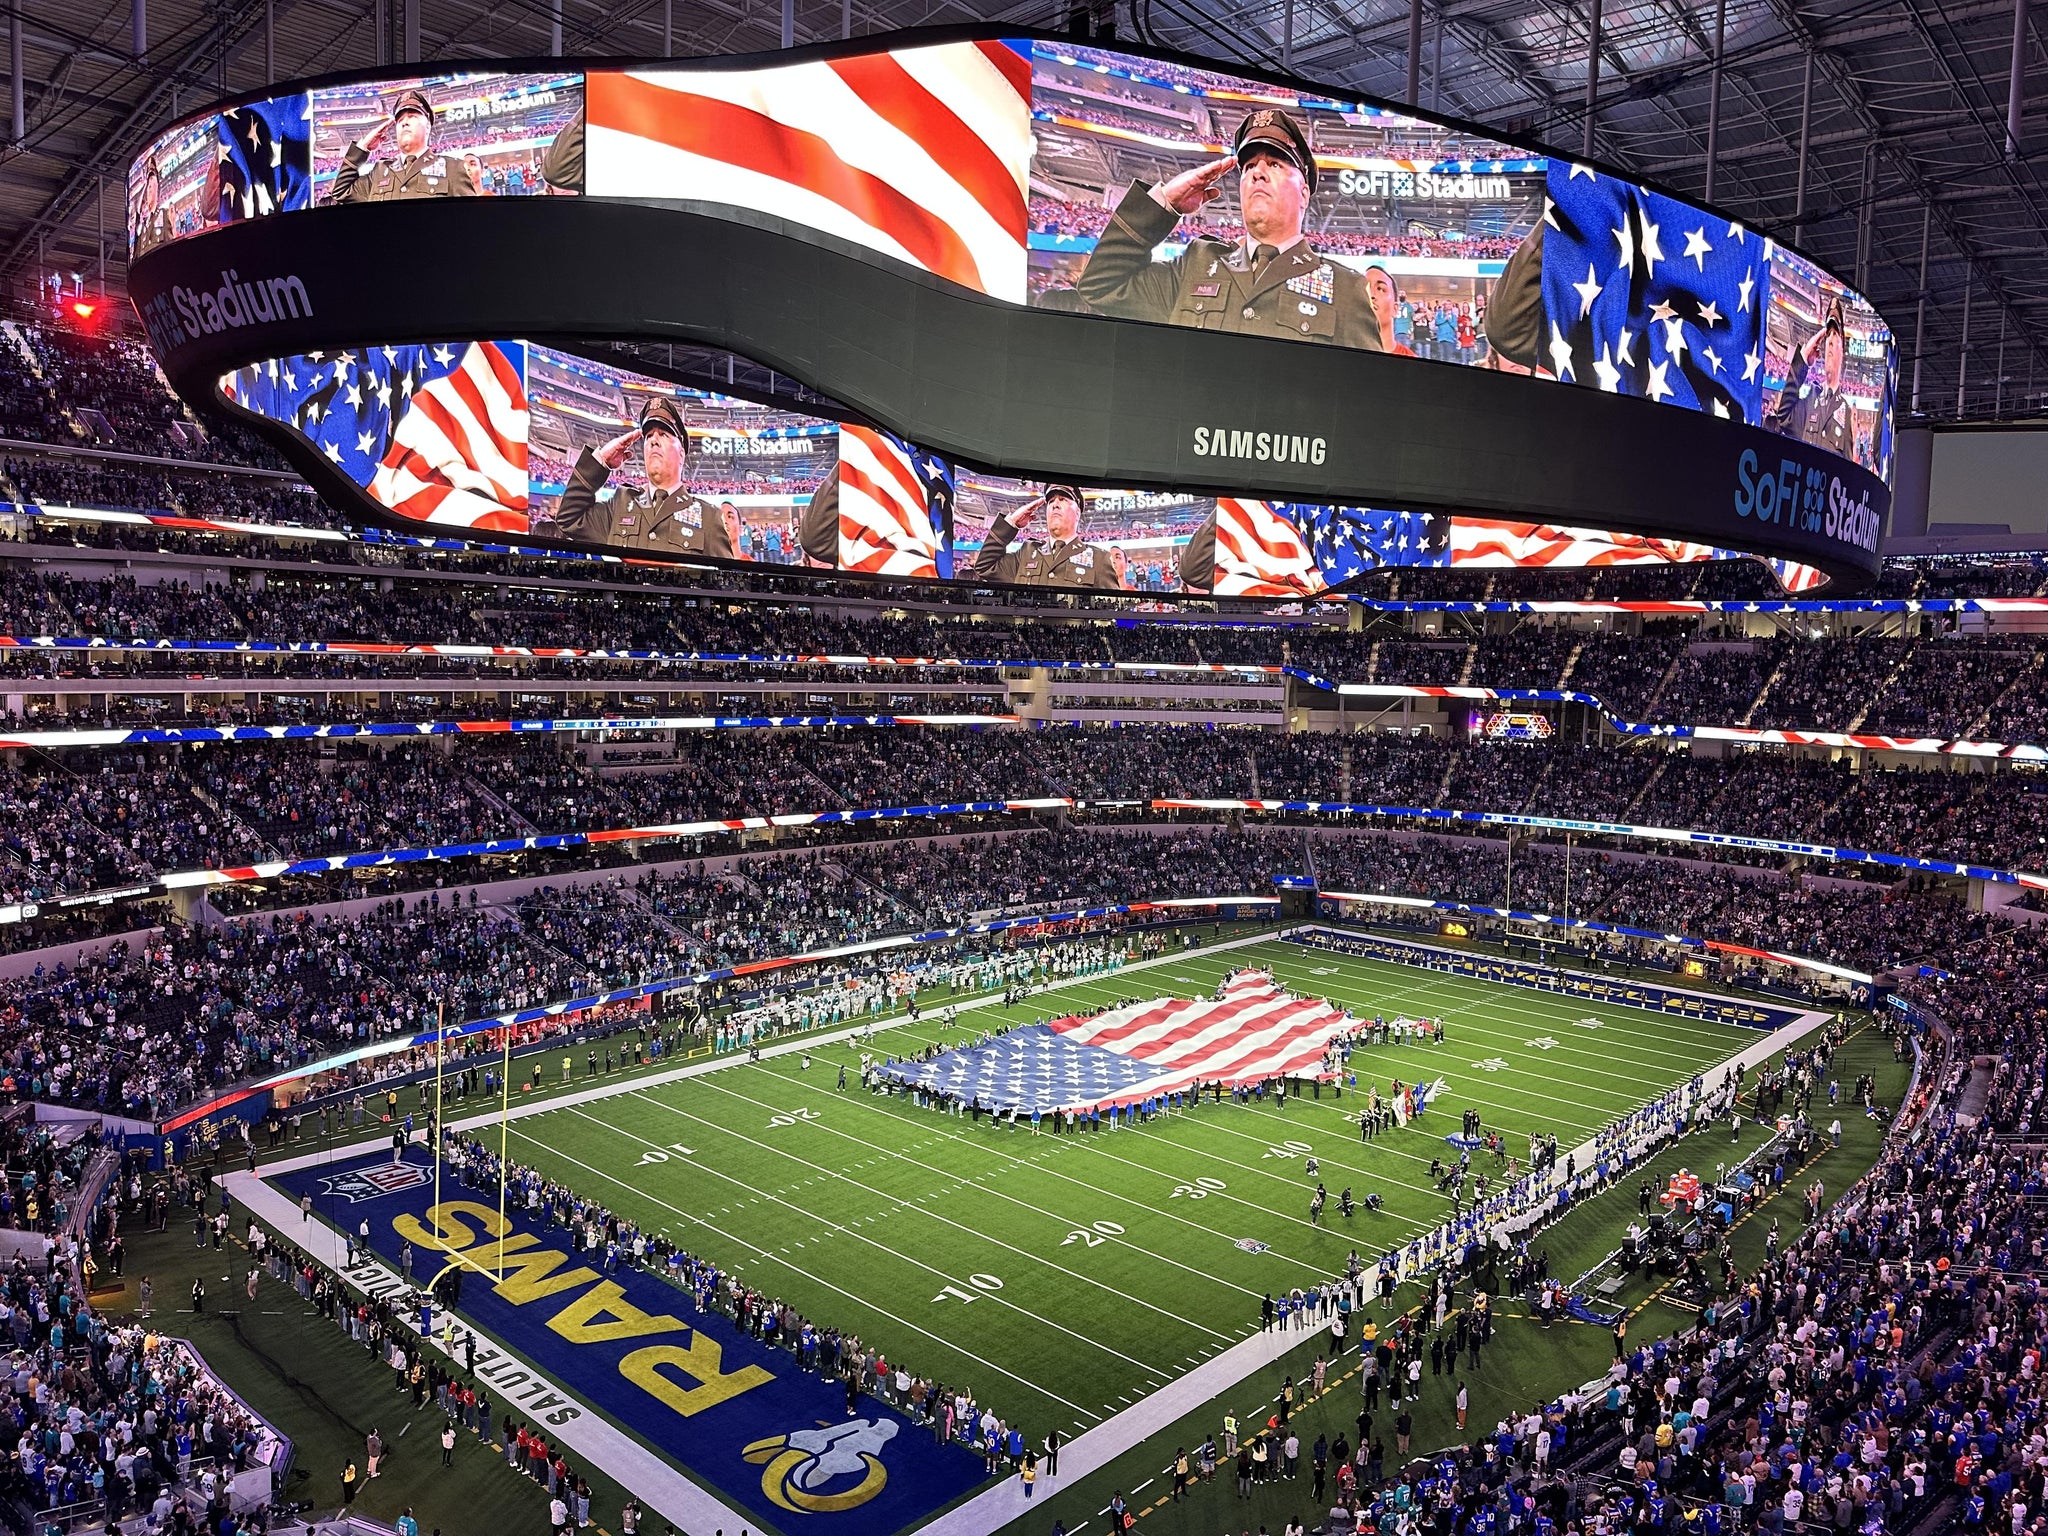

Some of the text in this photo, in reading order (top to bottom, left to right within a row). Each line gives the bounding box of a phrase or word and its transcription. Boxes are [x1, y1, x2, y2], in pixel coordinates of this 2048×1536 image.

[1339, 169, 1511, 199] SoFi Stadium
[172, 268, 314, 339] Stadium
[701, 437, 813, 455] SoFi Stadium
[1193, 425, 1327, 466] SAMSUNG
[1094, 496, 1122, 511] SoFi
[1734, 448, 1880, 554] SoFi Stadium
[25, 907, 36, 916] CC
[770, 1107, 822, 1126] 20
[641, 1142, 698, 1163] 10
[1270, 1140, 1313, 1160] 40
[1175, 1176, 1228, 1200] 30
[1069, 1220, 1126, 1248] 20
[939, 1273, 1004, 1305] 10
[391, 1200, 777, 1418] RAMS
[471, 1349, 582, 1426] SALUTE
[1485, 1451, 1494, 1463] 10
[1476, 1523, 1486, 1533] 99
[1487, 1512, 1495, 1522] 10
